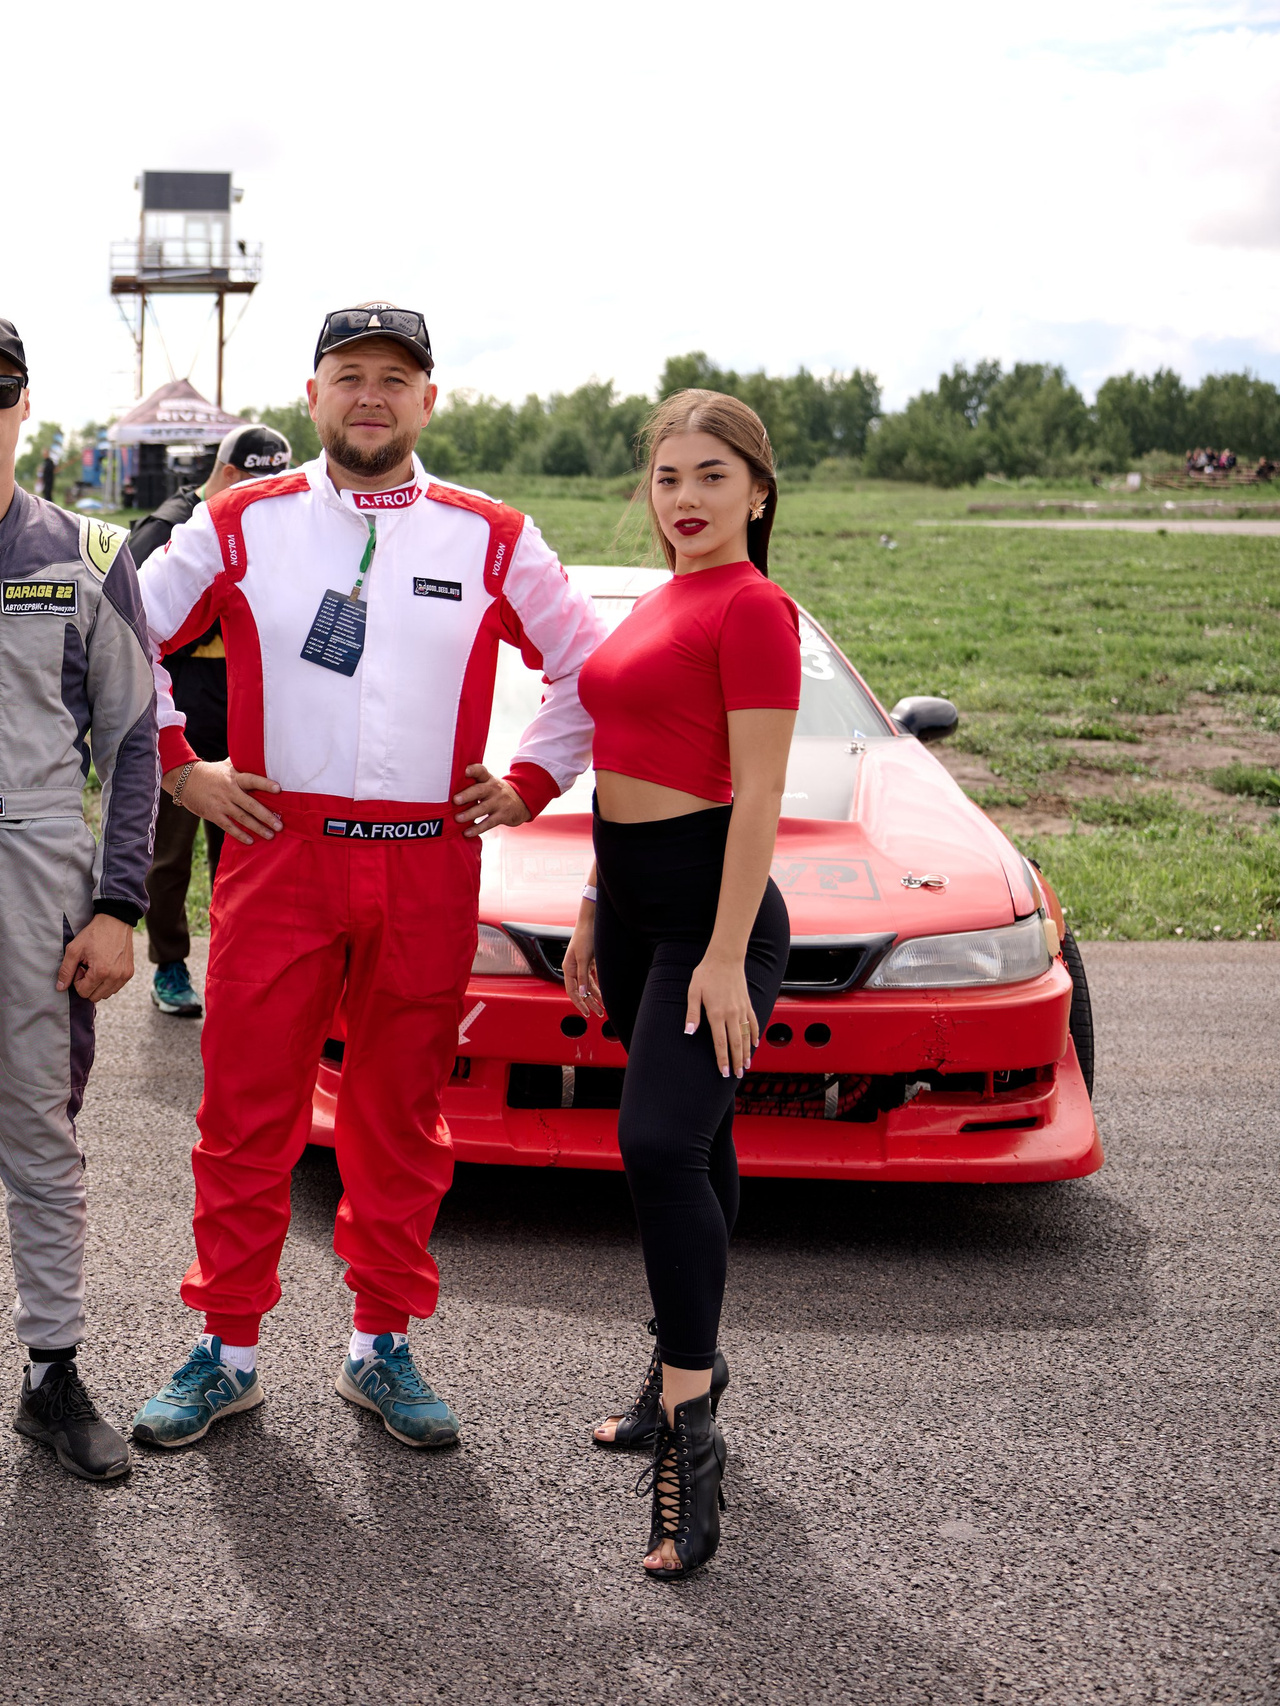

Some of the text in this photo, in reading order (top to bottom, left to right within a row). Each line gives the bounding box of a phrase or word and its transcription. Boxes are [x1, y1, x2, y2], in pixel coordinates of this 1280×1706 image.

[227, 534, 238, 566] VOLSON
[492, 543, 506, 577] VOLSON
[5, 585, 74, 599] GARAGE 22
[5, 603, 44, 611] АВТОСЕРВИС
